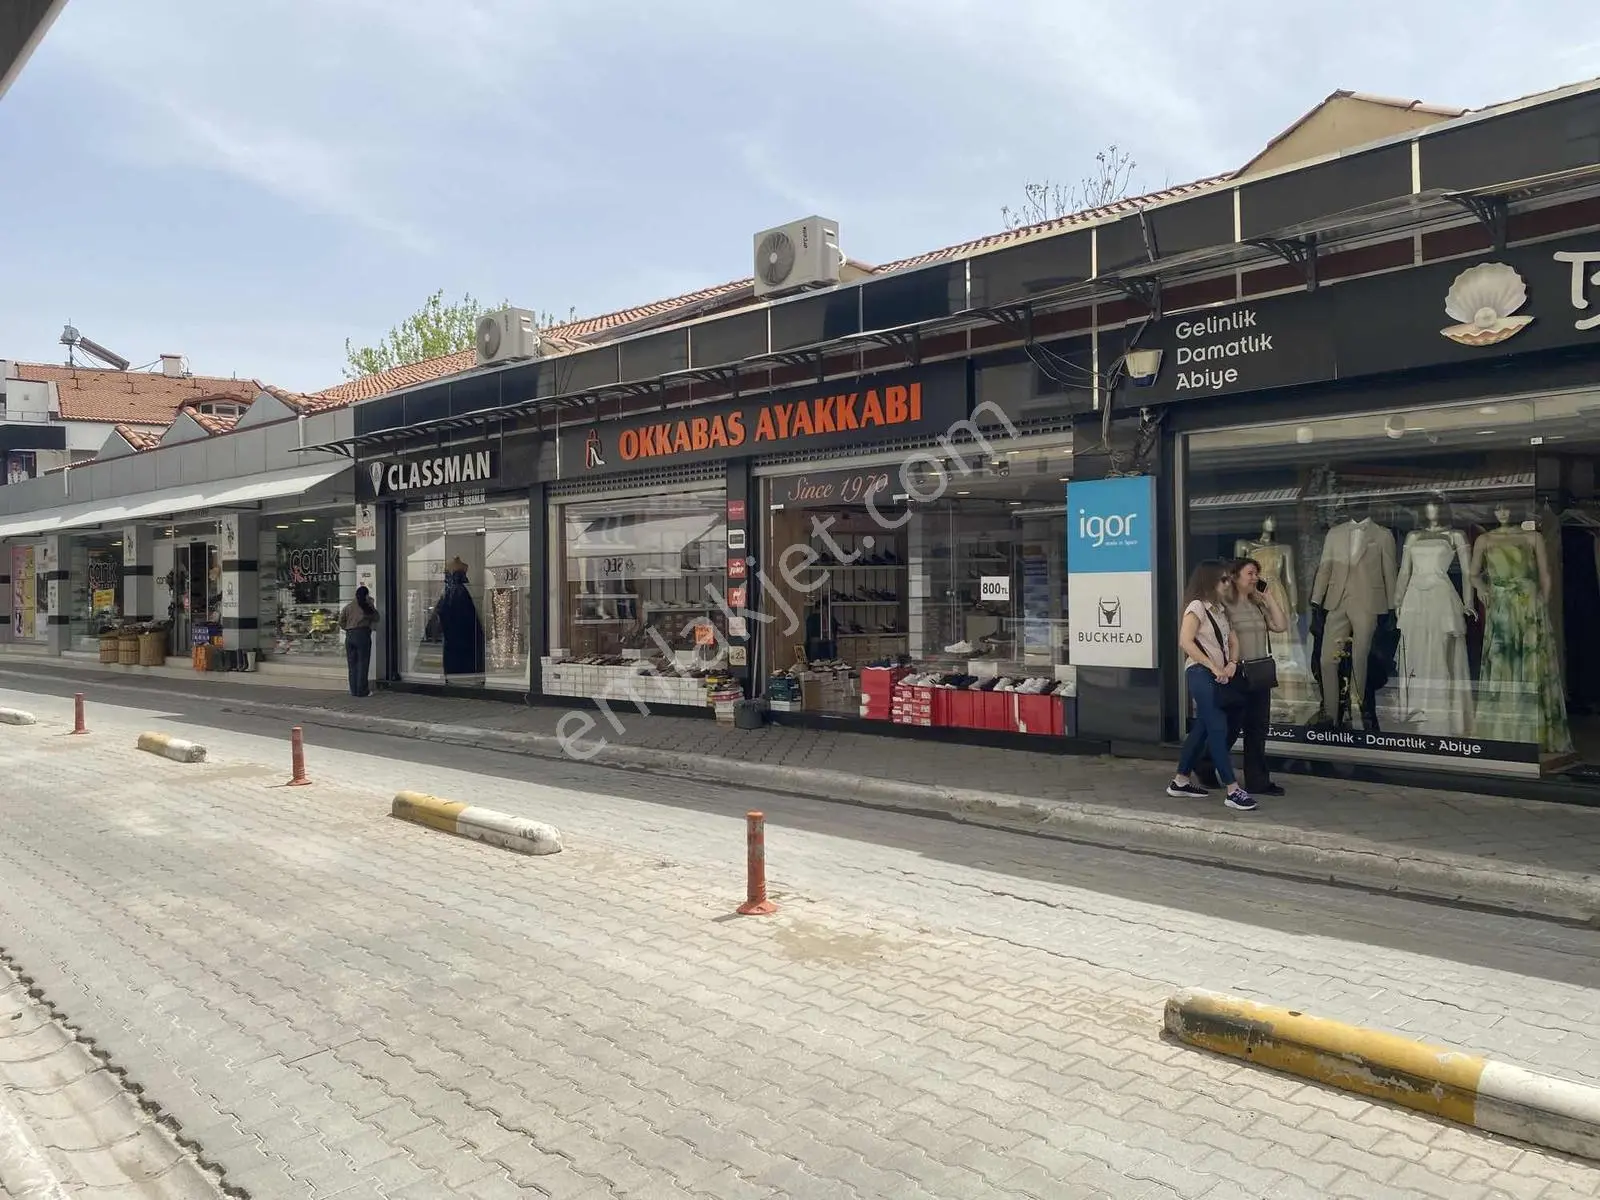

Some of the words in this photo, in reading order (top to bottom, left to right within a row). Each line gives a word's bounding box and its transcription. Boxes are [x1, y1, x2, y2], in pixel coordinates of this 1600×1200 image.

[1175, 310, 1257, 340] Gelinlik
[1176, 333, 1273, 366] Damatlık
[1176, 366, 1239, 392] Abiye
[618, 410, 746, 461] OKKABAS
[754, 383, 922, 443] AYAKKABI
[387, 450, 492, 492] CLASSMAN
[788, 477, 834, 501] Since
[840, 473, 889, 503] 1970
[1079, 508, 1137, 548] igor
[1078, 631, 1143, 644] BUCKHEAD
[1306, 730, 1354, 744] Gelinlik
[1366, 733, 1426, 750] Damatlık
[1439, 740, 1482, 755] Abiye
